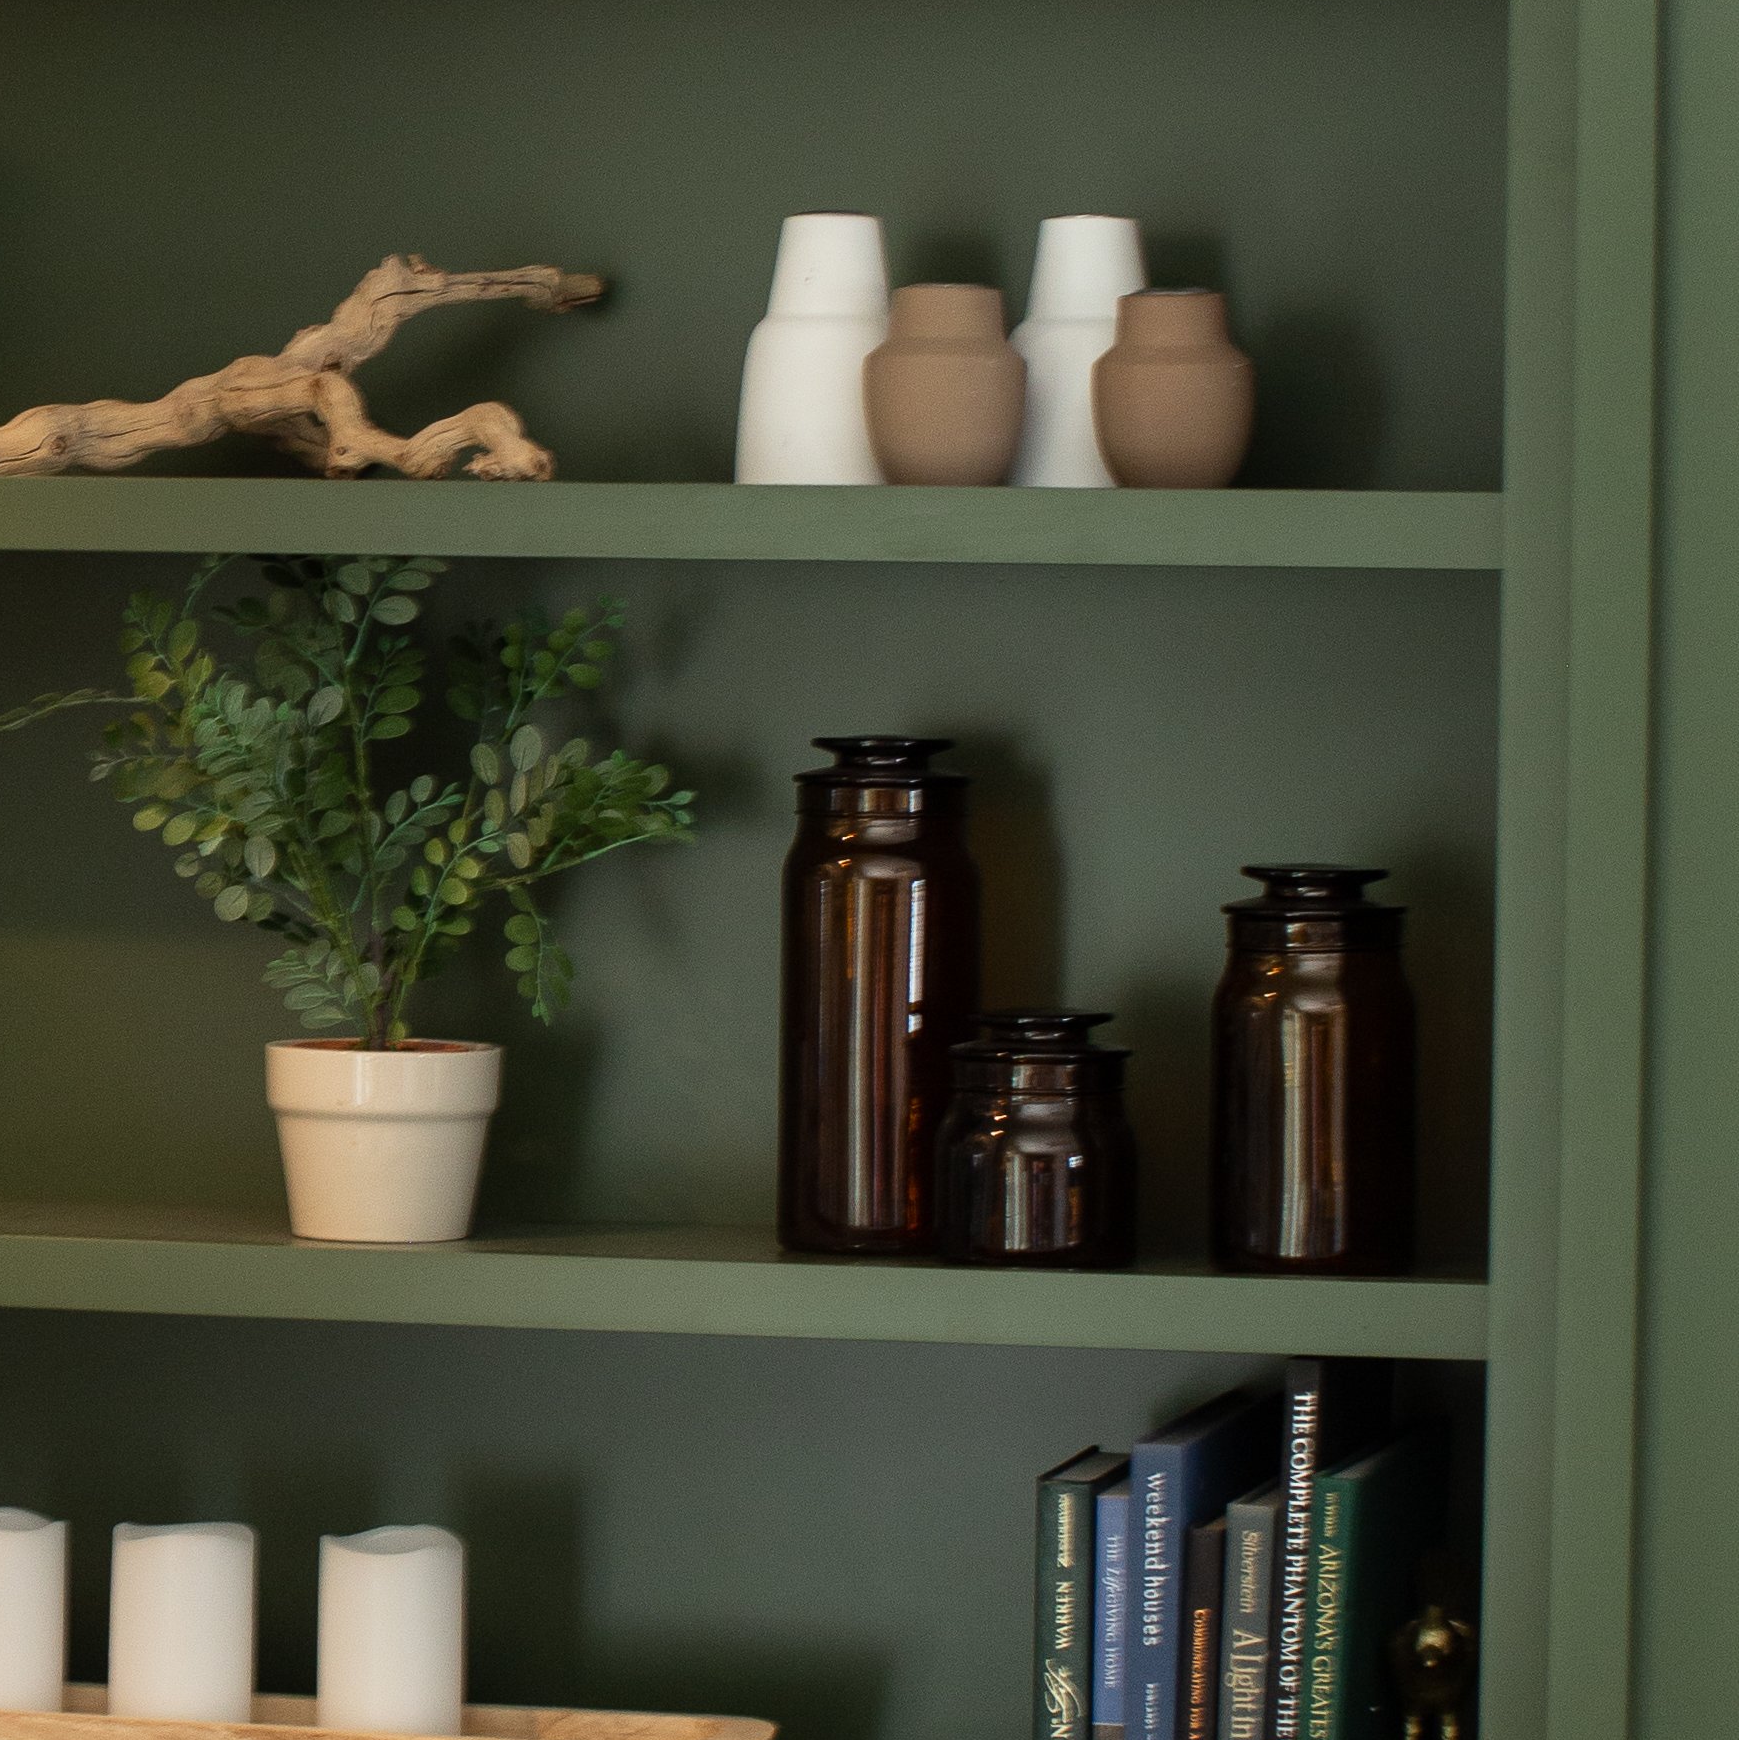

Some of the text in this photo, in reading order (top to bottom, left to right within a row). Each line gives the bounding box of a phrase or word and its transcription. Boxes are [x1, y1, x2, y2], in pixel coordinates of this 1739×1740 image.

[1292, 1391, 1318, 1435] THE
[1286, 1436, 1316, 1550] COMPLETE
[1105, 1534, 1122, 1562] THE
[1143, 1472, 1171, 1646] weekend houses
[1239, 1529, 1262, 1613] Silverstein
[1055, 1581, 1075, 1650] WARREN
[1280, 1554, 1309, 1662] PHANTOM
[1313, 1543, 1344, 1651] ARIZONA'S
[1232, 1629, 1268, 1649] A
[1104, 1648, 1120, 1688] HOME
[1224, 1653, 1268, 1713] Light
[1278, 1664, 1301, 1691] OF
[1230, 1716, 1257, 1738] in
[1276, 1696, 1300, 1739] THE
